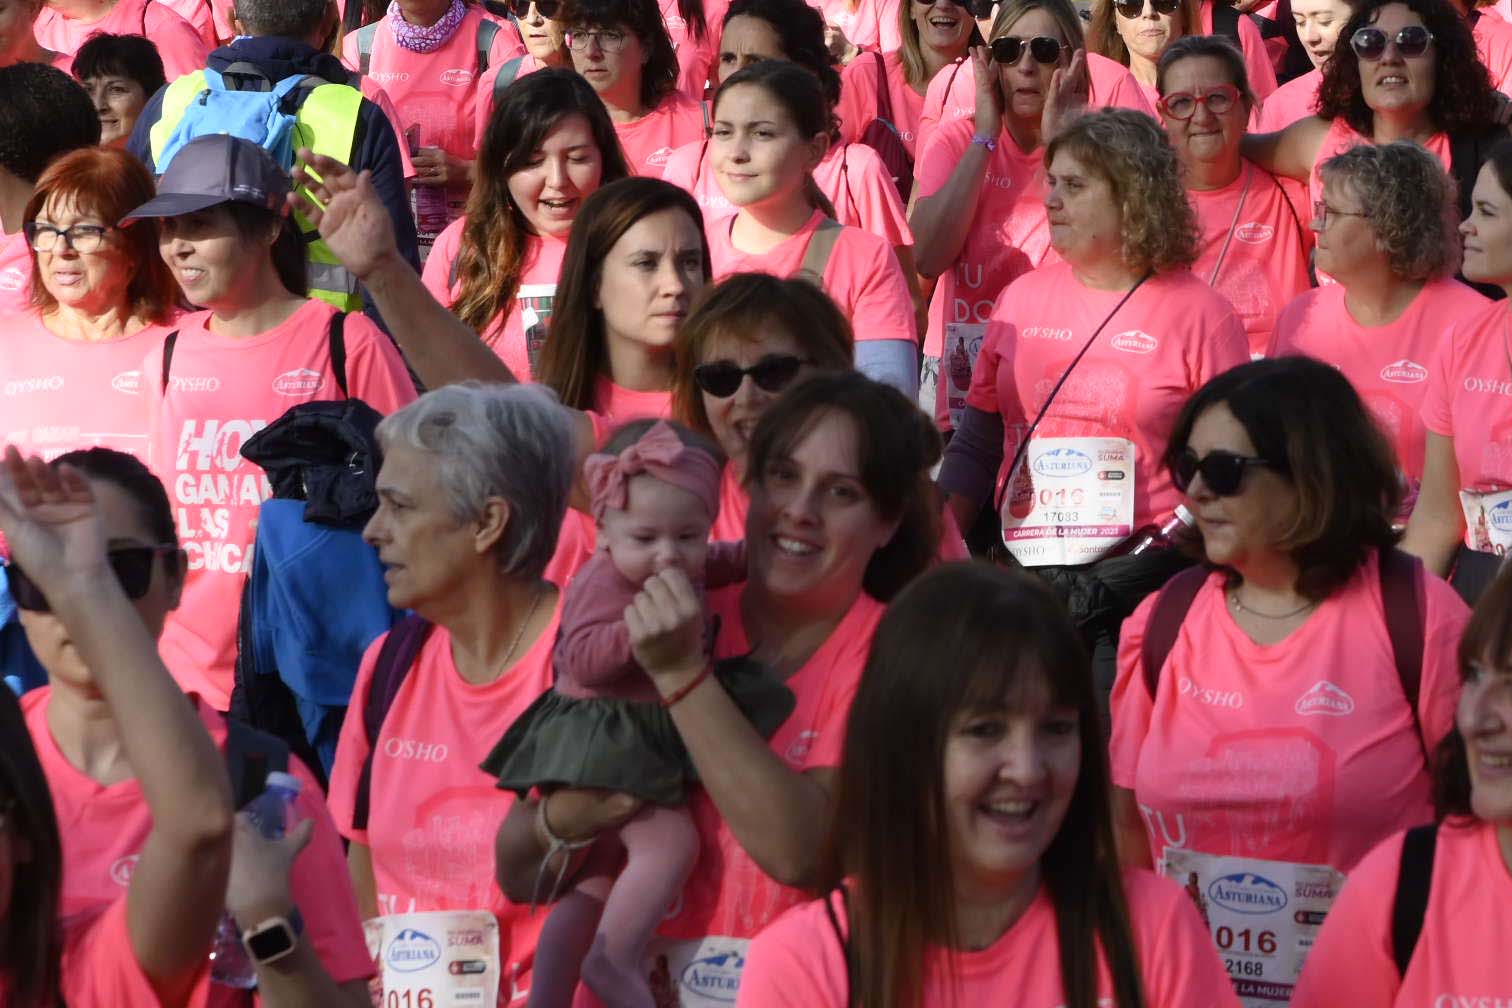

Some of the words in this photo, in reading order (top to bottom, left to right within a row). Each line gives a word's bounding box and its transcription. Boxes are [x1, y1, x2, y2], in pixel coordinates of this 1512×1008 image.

[954, 298, 994, 324] DO
[1022, 327, 1072, 341] OYSHO
[1039, 487, 1087, 508] 016
[178, 508, 230, 540] LAS
[1013, 528, 1044, 539] CARRERA
[1177, 677, 1244, 709] OYSHO
[1212, 883, 1282, 908] ASTURIANA
[1216, 925, 1278, 955] 016
